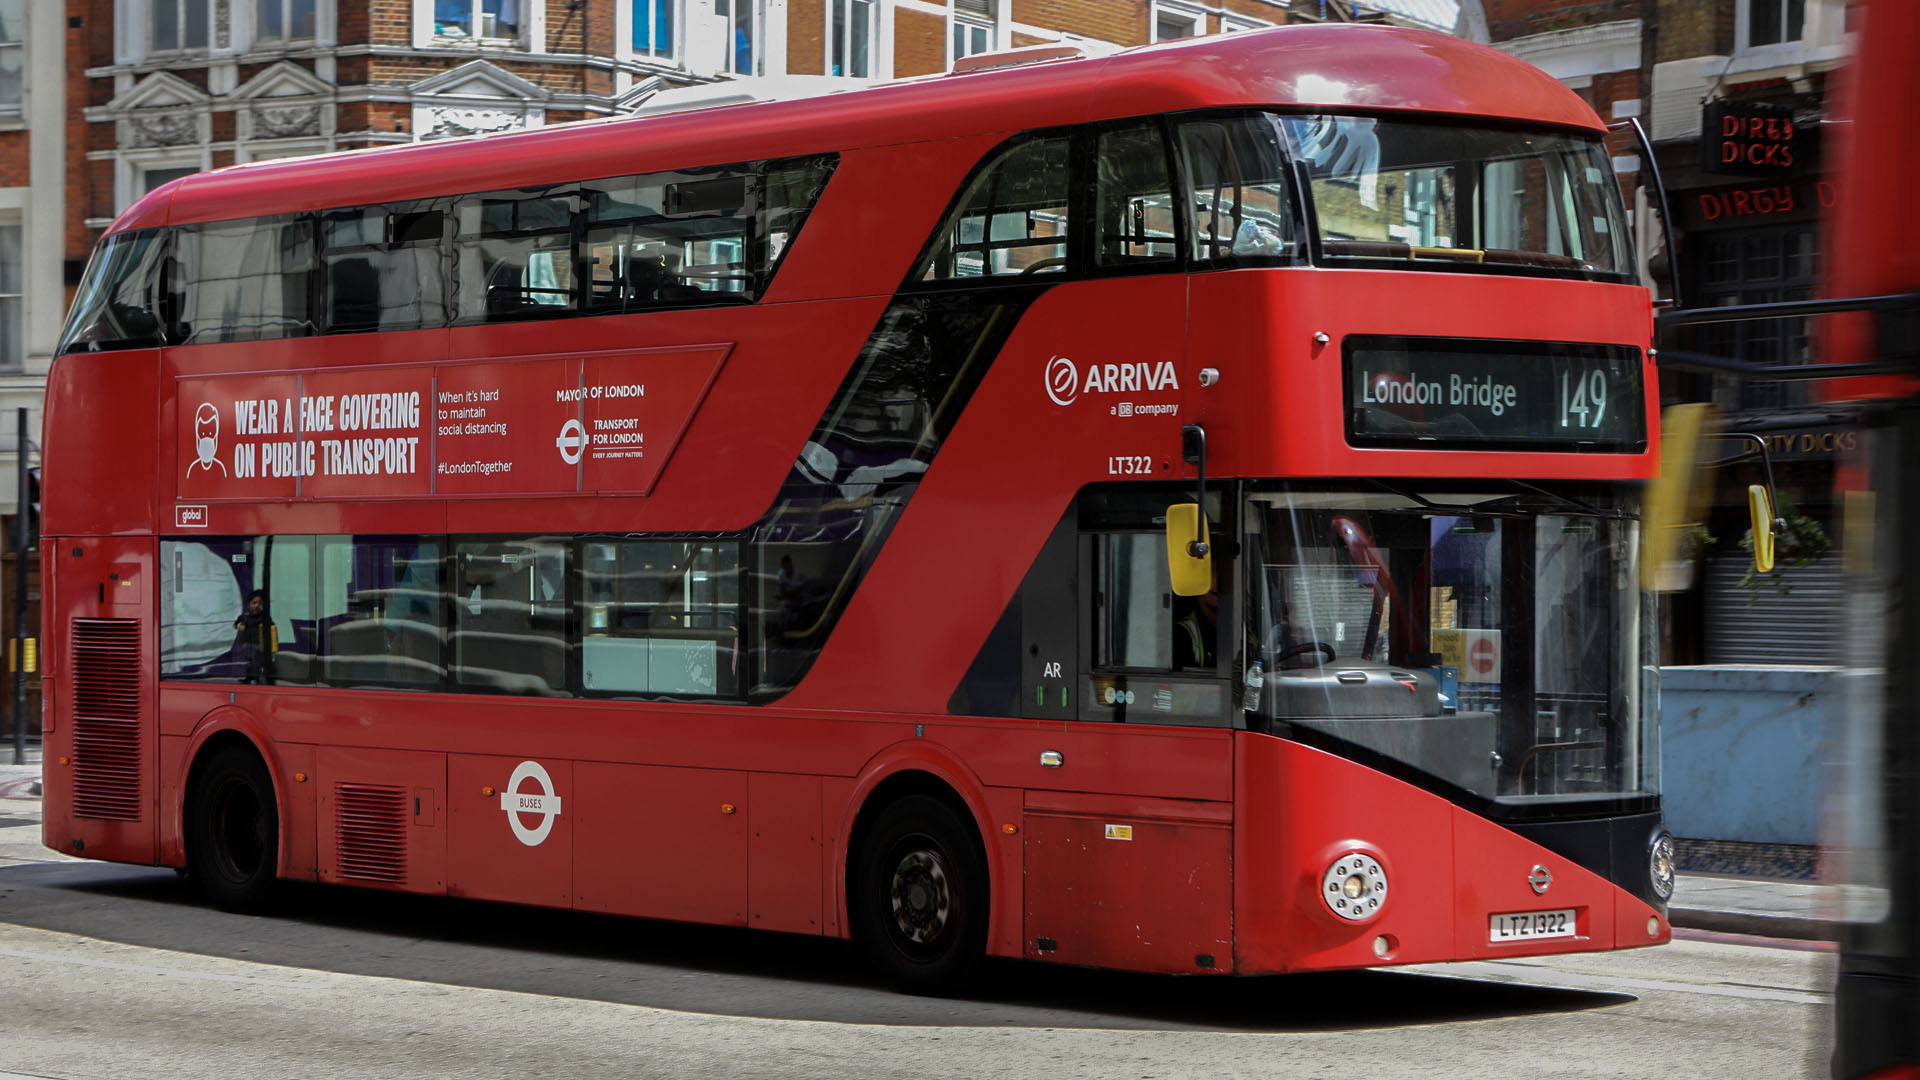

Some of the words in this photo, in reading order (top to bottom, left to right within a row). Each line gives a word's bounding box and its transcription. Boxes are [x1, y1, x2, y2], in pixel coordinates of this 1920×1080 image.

[1721, 141, 1793, 167] DICKS
[1700, 185, 1794, 220] DIRTY
[1083, 361, 1179, 393] ARRIVA
[438, 391, 463, 404] When
[465, 390, 478, 402] it's
[480, 389, 499, 401] hard
[556, 387, 588, 402] MAYOR
[590, 386, 603, 399] OF
[605, 385, 644, 398] LONDON
[1363, 371, 1442, 404] London
[1450, 374, 1516, 416] Bridge
[1561, 369, 1607, 428] 149
[235, 399, 278, 435] WEAR
[283, 398, 293, 433] A
[300, 395, 334, 432] FACE
[339, 391, 420, 431] COVERING
[438, 409, 448, 419] to
[450, 407, 486, 419] maintain
[1110, 406, 1116, 415] a
[1119, 403, 1133, 416] DB
[1135, 404, 1178, 416] company
[438, 424, 463, 436] social
[465, 421, 507, 436] distancing
[594, 418, 639, 430] TRANSPORT
[593, 434, 608, 444] FOR
[609, 433, 643, 444] LONDON
[1743, 434, 1796, 453] DRTY
[1801, 432, 1857, 452] DICKS
[234, 442, 255, 478] ON
[262, 440, 315, 478] PUBLIC
[321, 437, 419, 475] TRANSPORT
[1108, 456, 1152, 474] LT322
[438, 461, 512, 476] #LondonTogether
[182, 508, 202, 524] global
[1044, 662, 1061, 678] AR
[519, 798, 542, 809] BUSES
